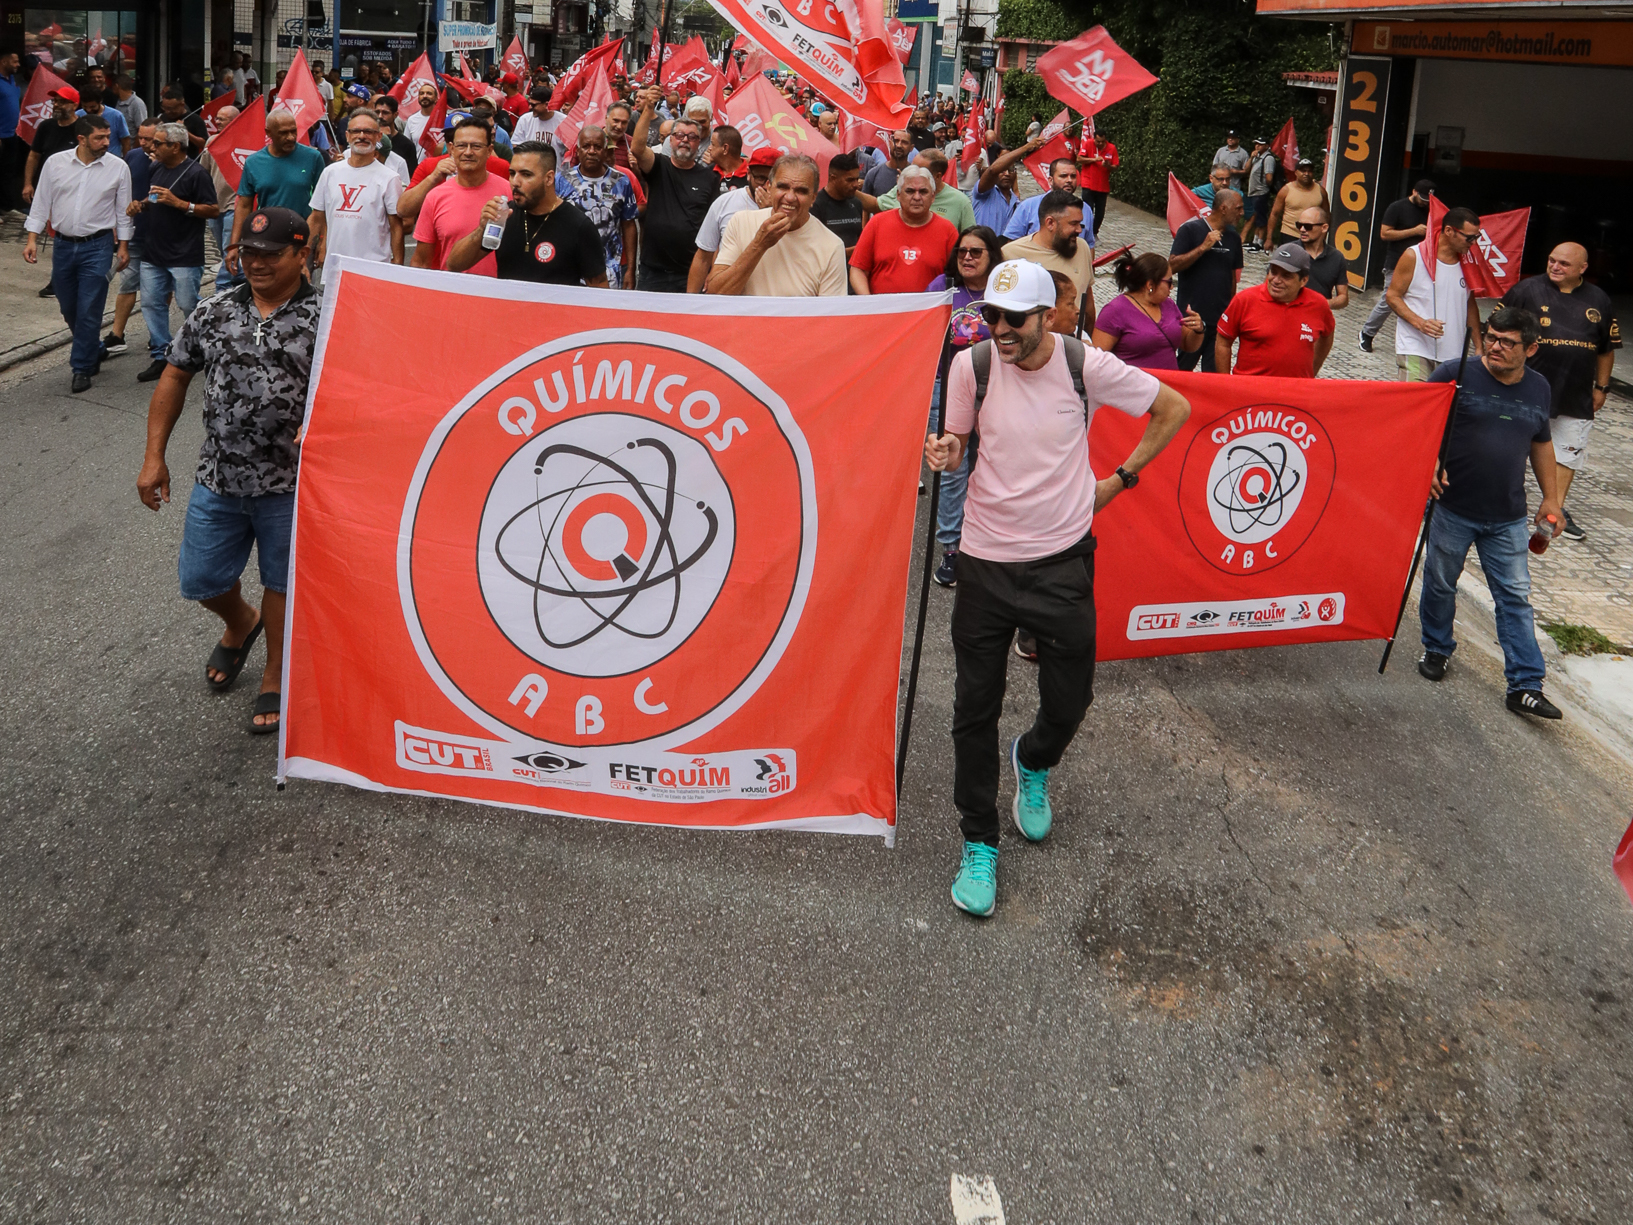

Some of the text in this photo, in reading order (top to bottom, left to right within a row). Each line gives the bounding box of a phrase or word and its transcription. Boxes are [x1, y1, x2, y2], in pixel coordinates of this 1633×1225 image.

[1391, 30, 1592, 57] marcio.automar@hotmail.com
[903, 249, 917, 260] 13
[497, 350, 750, 452] QUÍMICOS
[1211, 408, 1317, 450] QUÍMICOS
[1138, 615, 1176, 629] CUT
[405, 738, 493, 772] CUT BRASIL
[512, 768, 537, 778] CUT
